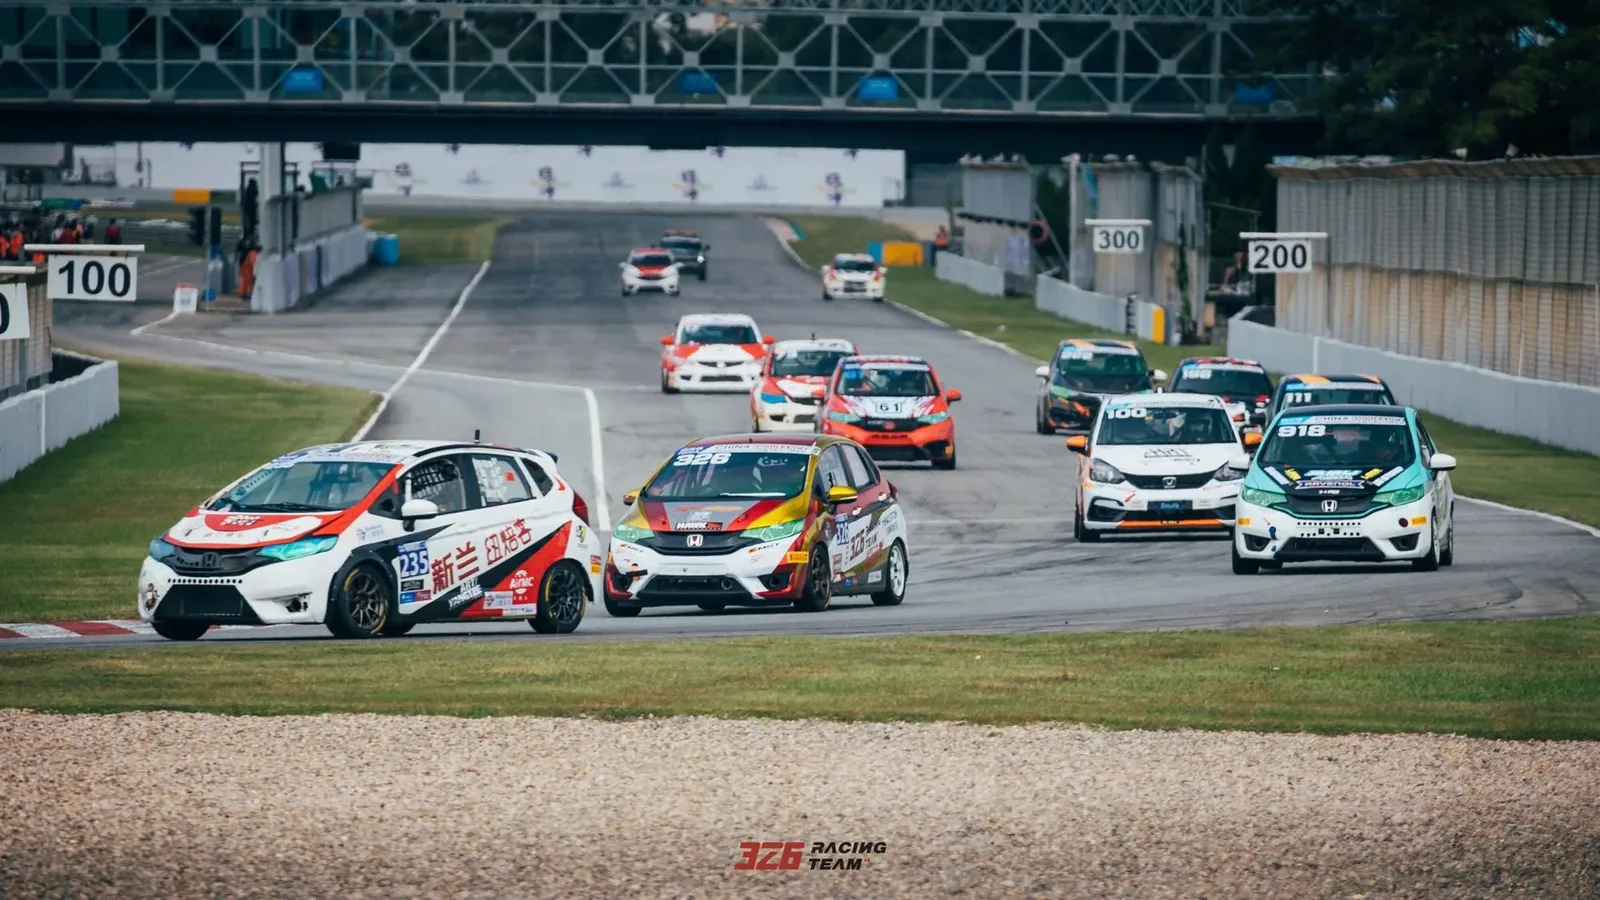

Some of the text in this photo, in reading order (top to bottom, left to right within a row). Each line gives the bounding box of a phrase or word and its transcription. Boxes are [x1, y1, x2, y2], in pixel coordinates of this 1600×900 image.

[1098, 230, 1140, 250] 300
[1253, 244, 1308, 269] 200
[58, 260, 131, 298] 100
[1285, 392, 1312, 403] 111
[879, 402, 900, 412] 61
[1107, 408, 1147, 419] 100
[1278, 425, 1327, 437] 918
[673, 453, 731, 467] 326
[676, 521, 708, 530] HAWK
[837, 523, 850, 544] 326
[400, 550, 429, 578] 235
[431, 541, 480, 594] 新兰
